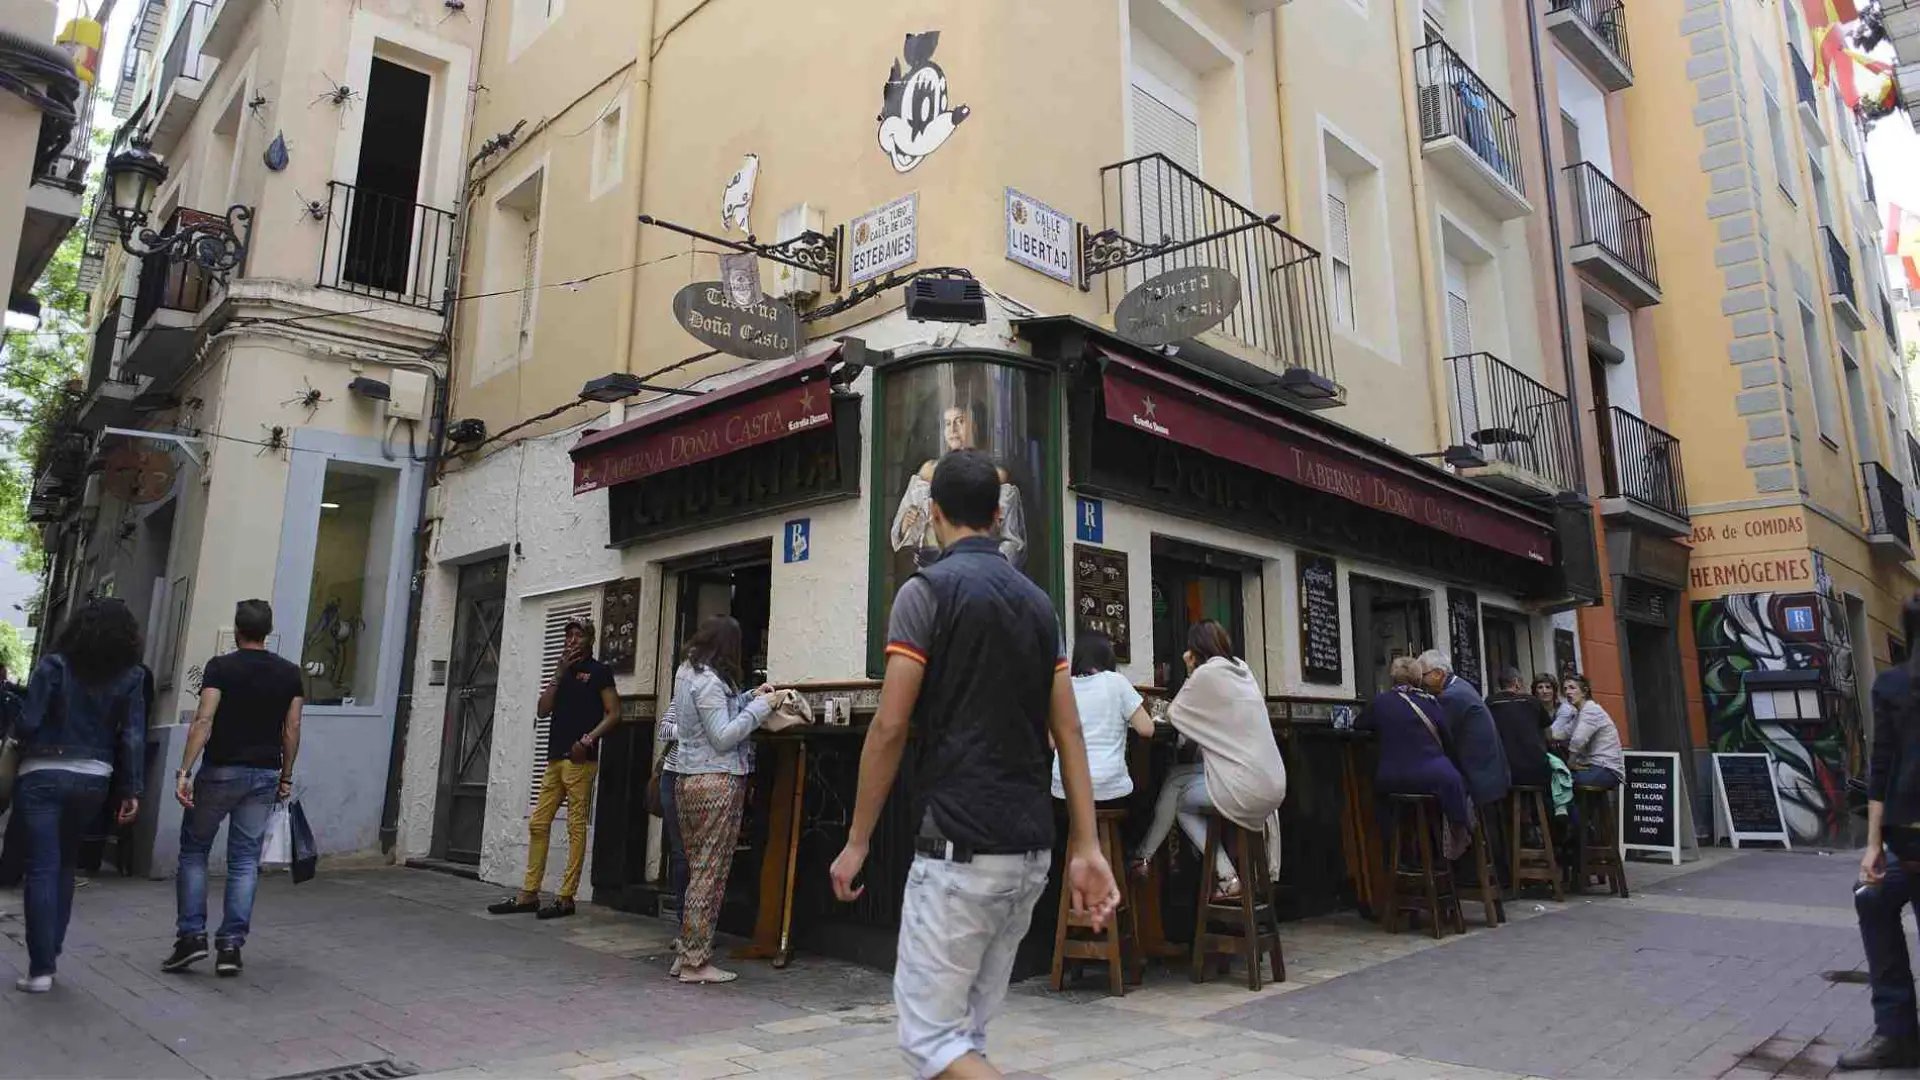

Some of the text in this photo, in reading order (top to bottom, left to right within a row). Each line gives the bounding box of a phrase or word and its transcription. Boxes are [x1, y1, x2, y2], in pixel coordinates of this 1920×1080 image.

[870, 215, 911, 242] CALLE DE LOS
[1035, 210, 1060, 234] CALLE
[853, 233, 911, 273] ESTEBANES
[1013, 229, 1068, 270] LIBERTAD
[688, 309, 731, 337] Doña
[602, 448, 664, 483] TABERNA
[726, 409, 785, 445] CASTA
[1290, 447, 1362, 500] TABERNA
[1722, 524, 1738, 540] de
[1744, 516, 1803, 538] COMIDAS
[1690, 559, 1809, 588] HERMÓGENES
